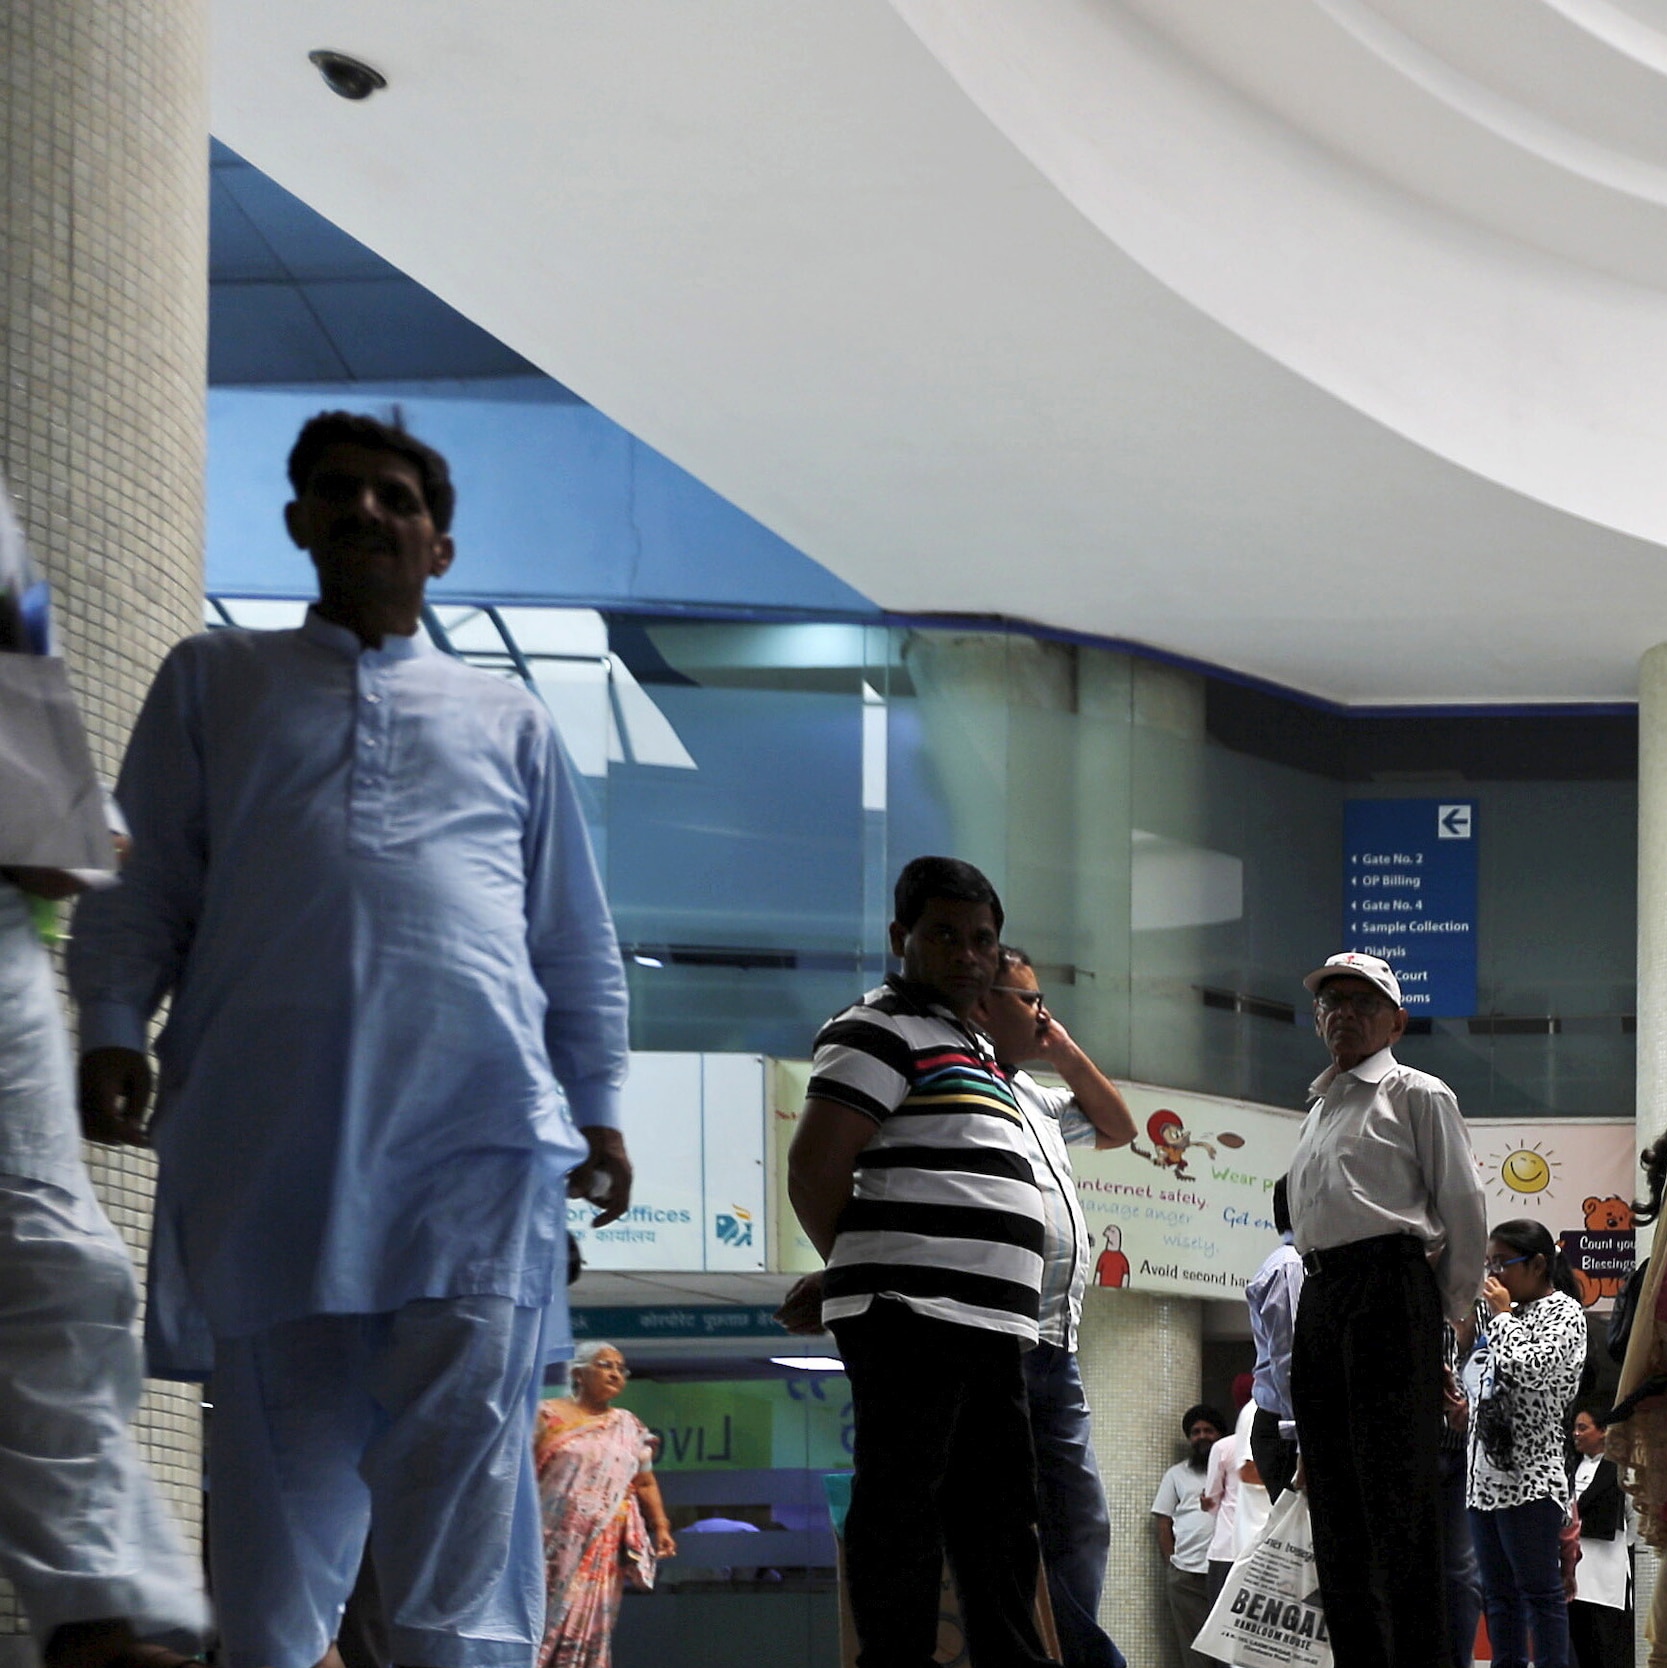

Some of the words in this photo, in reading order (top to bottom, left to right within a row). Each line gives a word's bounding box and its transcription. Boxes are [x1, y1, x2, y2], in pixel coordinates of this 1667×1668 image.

[1362, 853, 1391, 865] Gate
[1393, 853, 1413, 865] No.
[1415, 852, 1424, 864] 2
[1362, 875, 1380, 886] OP
[1382, 875, 1421, 888] Billing
[1362, 899, 1391, 911] Gate
[1393, 899, 1413, 911] No.
[1415, 899, 1423, 910] 4
[1362, 921, 1407, 936] Sample
[1408, 920, 1469, 932] Collection
[1364, 945, 1406, 958] Dialysis
[1395, 970, 1428, 981] Court
[1400, 994, 1431, 1003] ooms
[1211, 1166, 1258, 1186] Wear
[1077, 1177, 1153, 1198] internet
[1159, 1189, 1211, 1210] safely.
[1145, 1207, 1193, 1228] anger
[1223, 1206, 1249, 1229] Get
[1580, 1235, 1613, 1251] Count
[1140, 1259, 1179, 1281] Avoid
[1182, 1269, 1227, 1288] second
[1231, 1587, 1330, 1643] BENGAL
[1234, 1618, 1283, 1643] HANDLOOM
[1284, 1630, 1313, 1651] HOUSE
